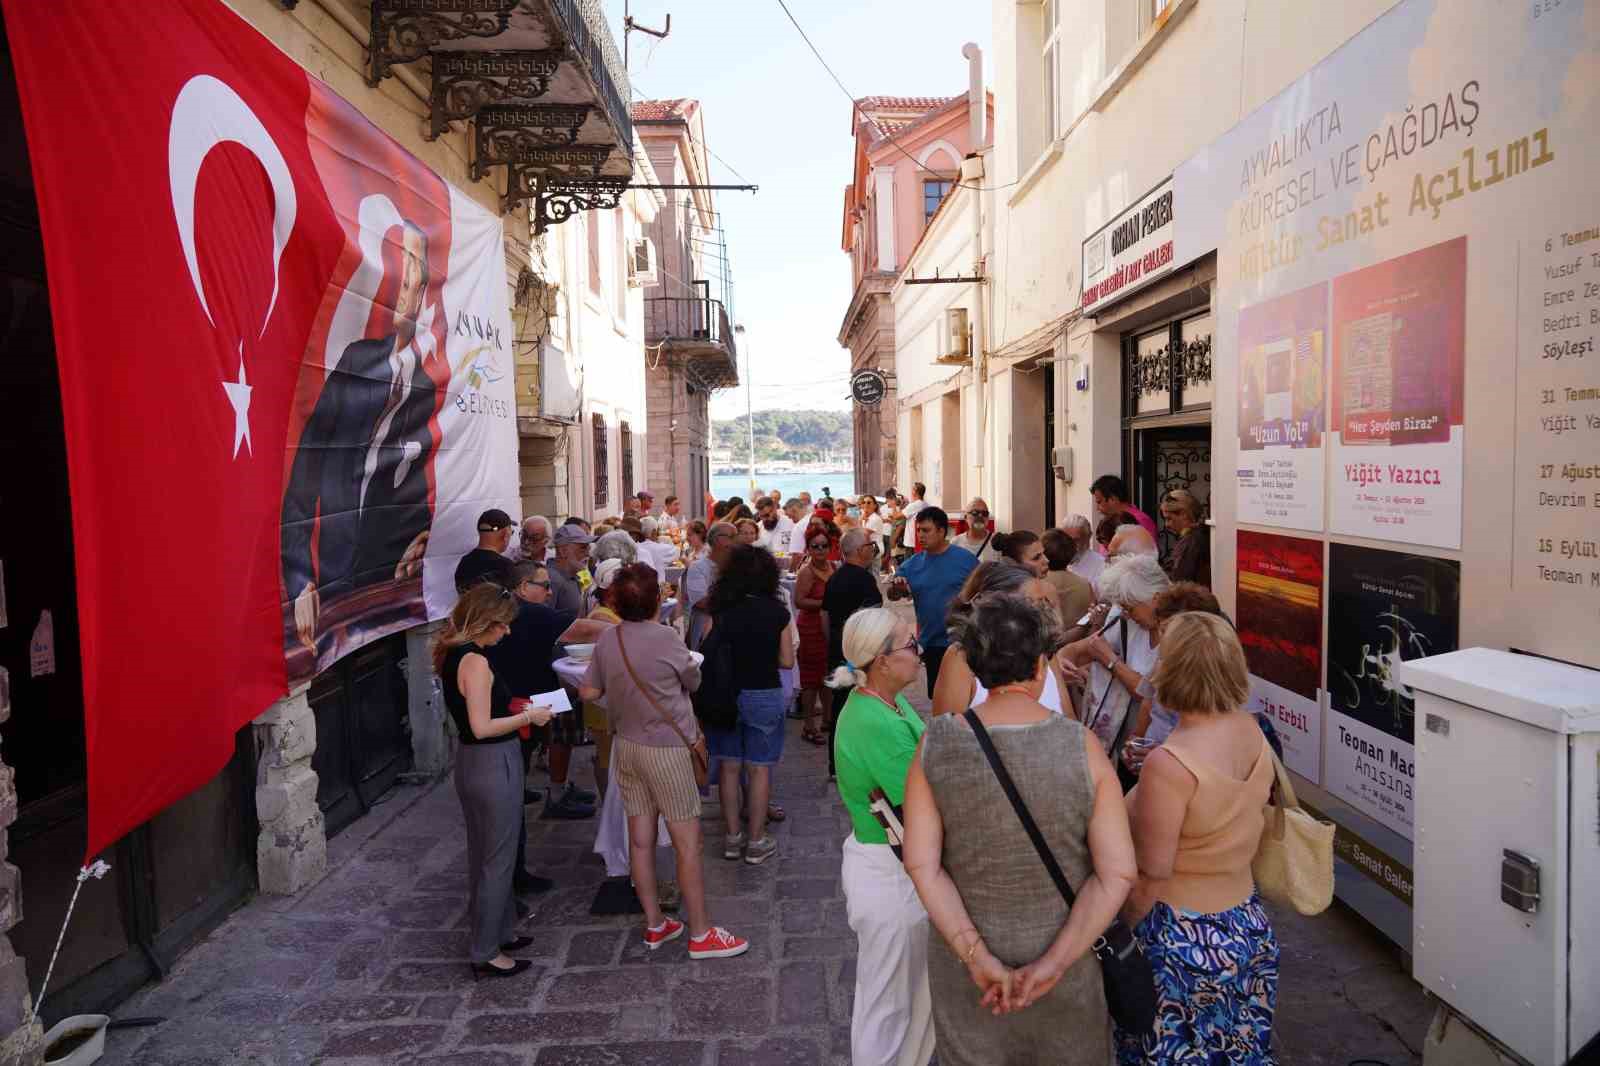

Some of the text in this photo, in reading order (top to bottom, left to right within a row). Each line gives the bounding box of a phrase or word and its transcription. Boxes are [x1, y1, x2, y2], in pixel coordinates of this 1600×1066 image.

[1240, 80, 1480, 236] KÜRESEL VE ÇAĞDAŞ
[1315, 192, 1390, 252] Sanat
[1408, 128, 1554, 220] Açılımı
[1111, 190, 1173, 257] ORHAN PEKER
[1545, 238, 1552, 252] 6
[1544, 256, 1584, 280] Yusuf
[1544, 289, 1575, 307] Emre
[1544, 311, 1581, 332] Bedri
[1542, 336, 1593, 361] Söyleşi
[1542, 389, 1555, 404] 31
[1541, 416, 1577, 435] Yiğit
[1344, 462, 1441, 488] Yiğit Yazıcı
[1541, 464, 1554, 478] 17
[1539, 491, 1586, 507] Devrim
[1539, 538, 1599, 559] 15 Eylül
[1536, 565, 1583, 584] Teoman
[1279, 704, 1308, 733] Erbil
[1338, 725, 1384, 763] Teoman
[1352, 843, 1383, 876] Sanat
